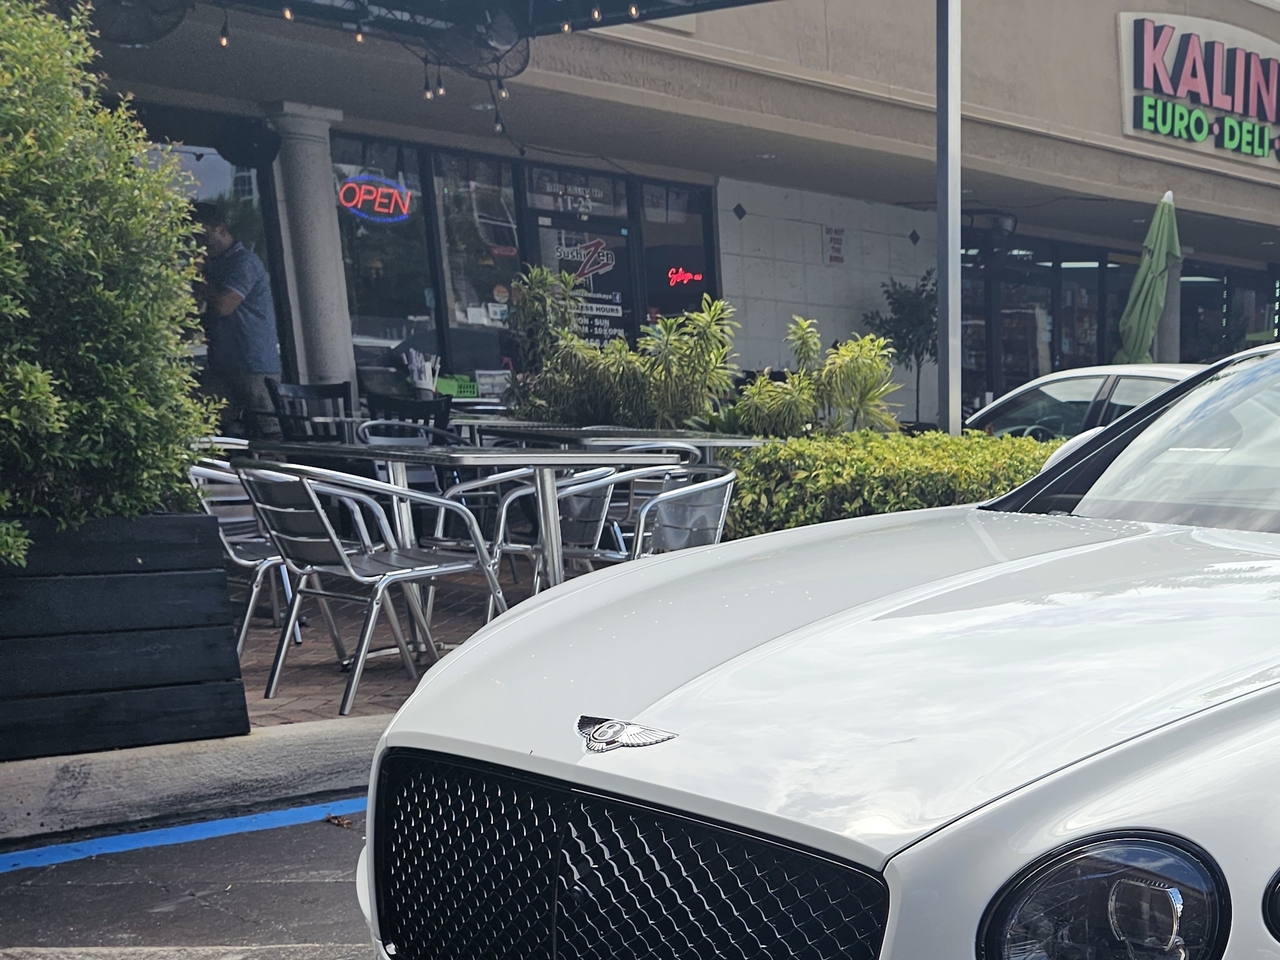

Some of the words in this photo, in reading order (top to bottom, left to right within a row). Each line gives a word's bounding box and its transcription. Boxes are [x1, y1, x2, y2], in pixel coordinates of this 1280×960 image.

[1137, 96, 1209, 143] EURO
[1218, 116, 1270, 158] DELI
[339, 182, 412, 216] OPEN
